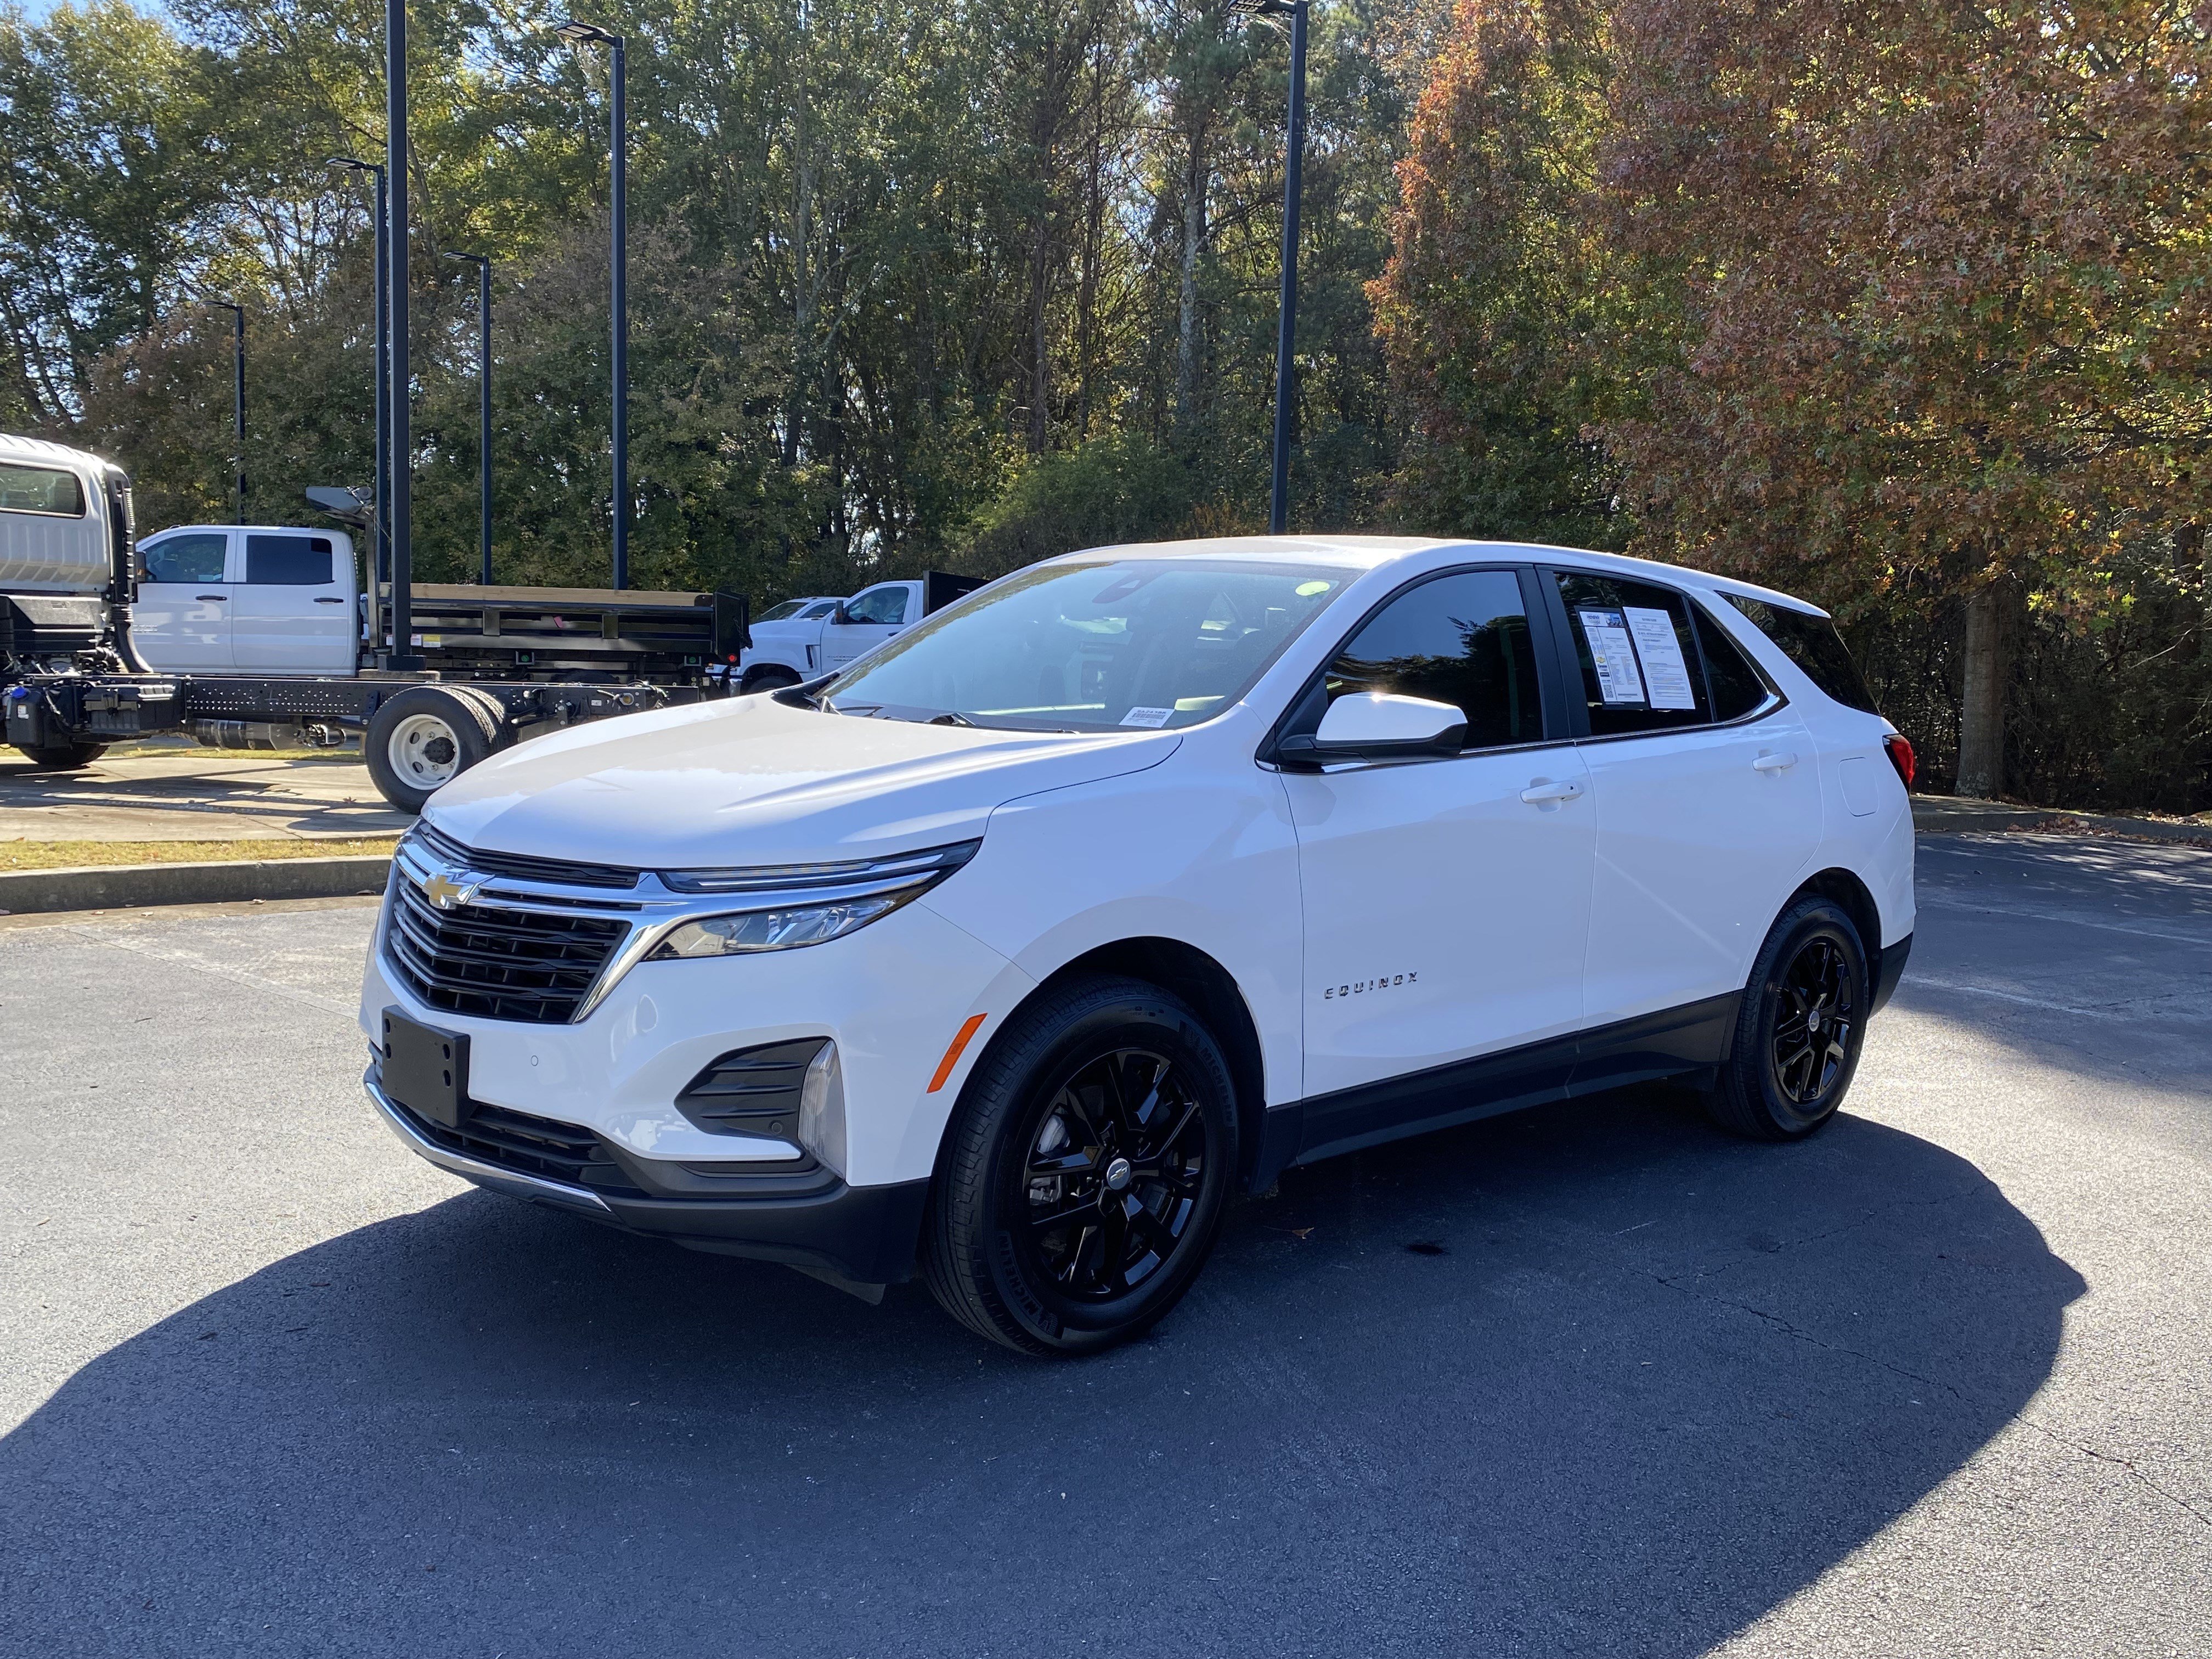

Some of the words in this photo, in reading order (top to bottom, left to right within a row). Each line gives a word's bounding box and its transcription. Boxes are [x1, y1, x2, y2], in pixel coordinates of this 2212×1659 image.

[1324, 972, 1418, 1000] EQUINOX
[1200, 1047, 1233, 1124] MICHELIN
[998, 1235, 1039, 1316] MICHELIN
